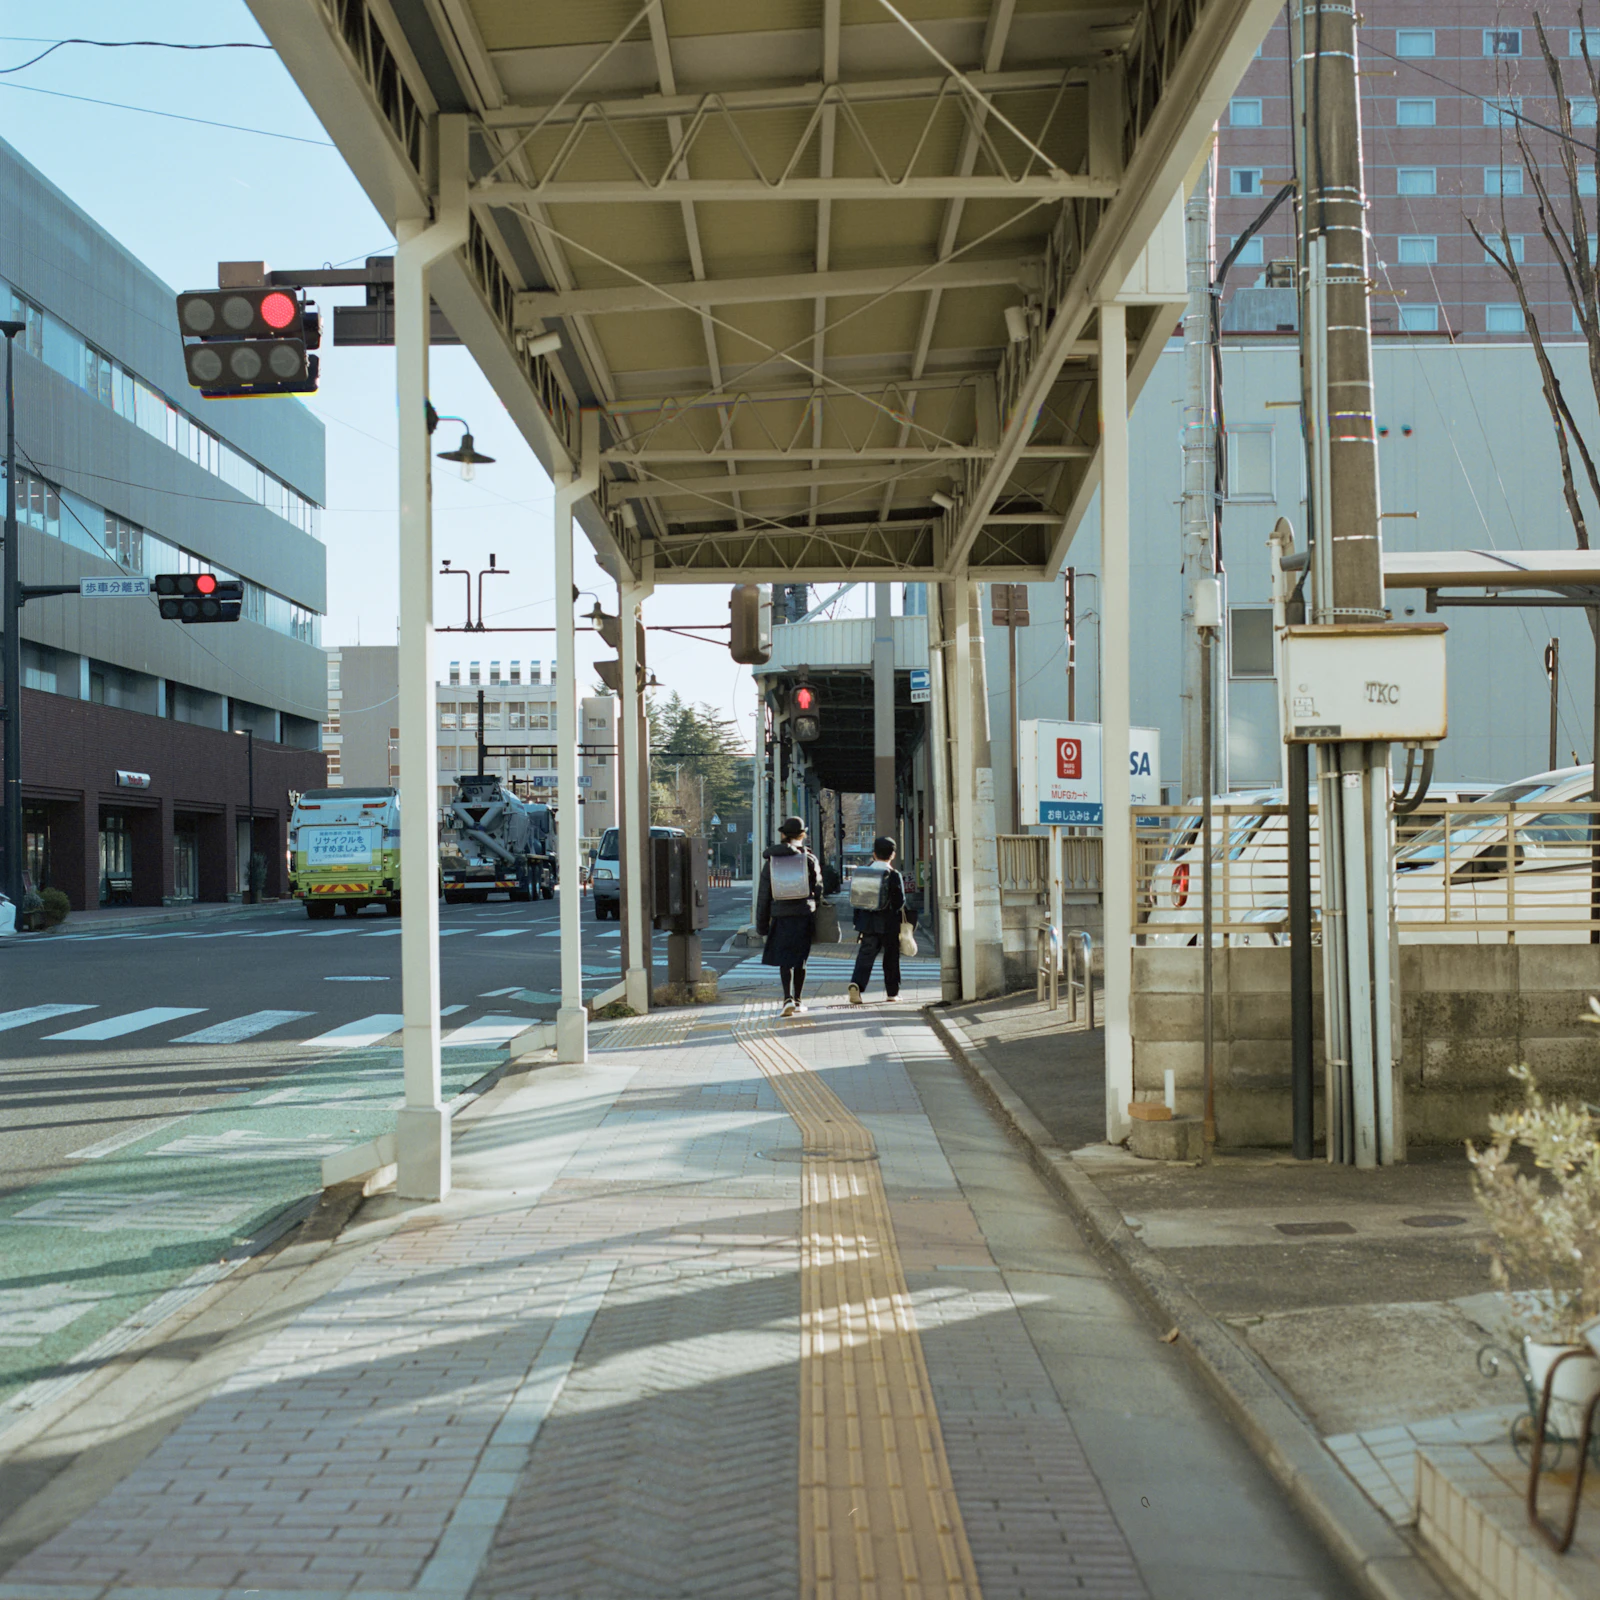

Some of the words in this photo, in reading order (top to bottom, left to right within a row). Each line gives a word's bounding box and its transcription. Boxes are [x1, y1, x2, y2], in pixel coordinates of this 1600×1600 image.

[85, 582, 145, 593] 歩車分離式
[1366, 681, 1400, 704] TKC
[1130, 751, 1151, 776] SA
[466, 786, 484, 795] 301
[1051, 790, 1088, 800] MUFGカード
[1130, 793, 1147, 803] カード
[1047, 810, 1090, 821] お申し込みは
[315, 836, 364, 845] リサイクルを
[313, 844, 367, 853] すすめましょう
